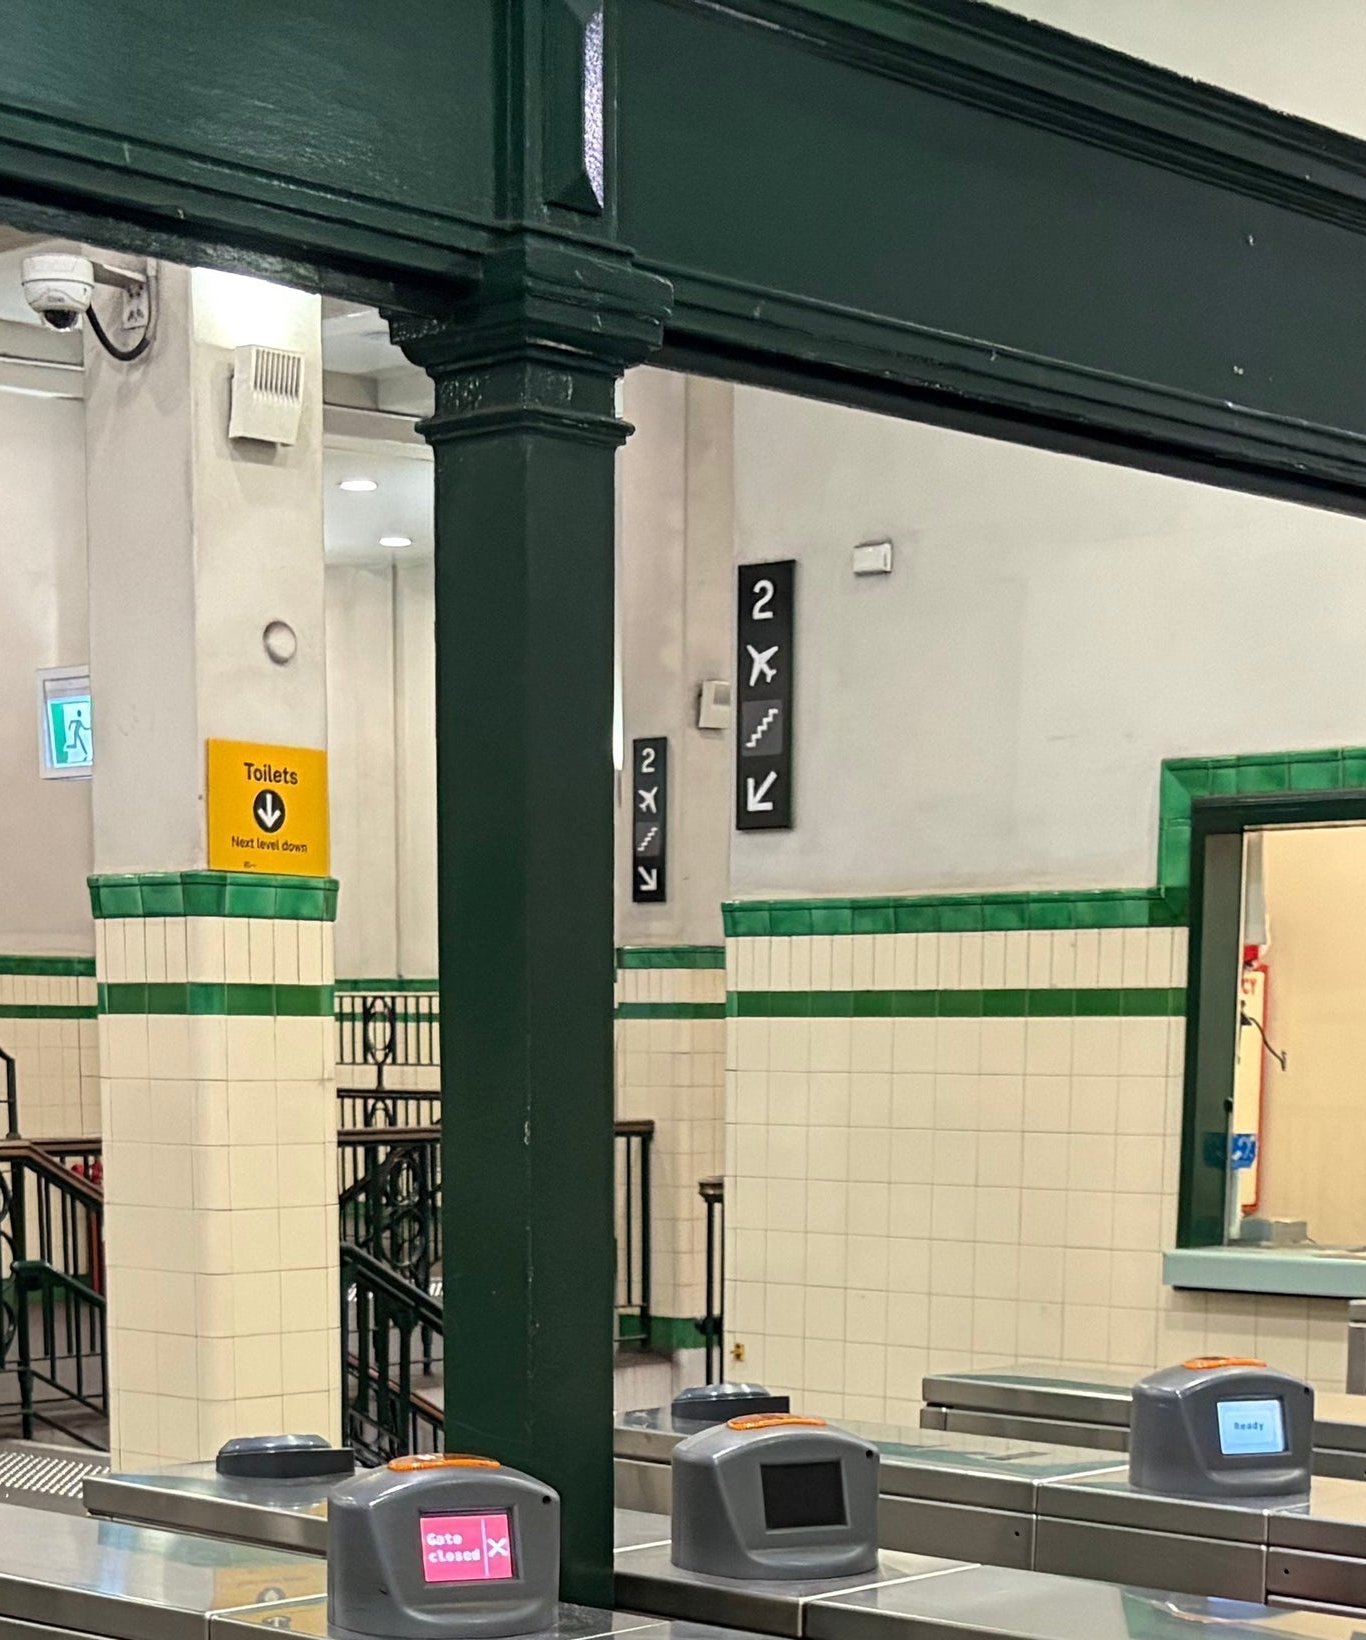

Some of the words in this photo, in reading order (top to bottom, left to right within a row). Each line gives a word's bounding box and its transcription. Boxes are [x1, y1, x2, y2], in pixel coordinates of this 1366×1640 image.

[752, 579, 775, 620] 2
[641, 747, 656, 773] 2
[243, 762, 298, 785] Toilets
[231, 836, 255, 849] Next
[257, 837, 280, 851] level
[281, 840, 308, 853] down
[1234, 1422, 1264, 1431] Ready
[426, 1533, 463, 1546] Gate
[428, 1548, 480, 1563] closed
